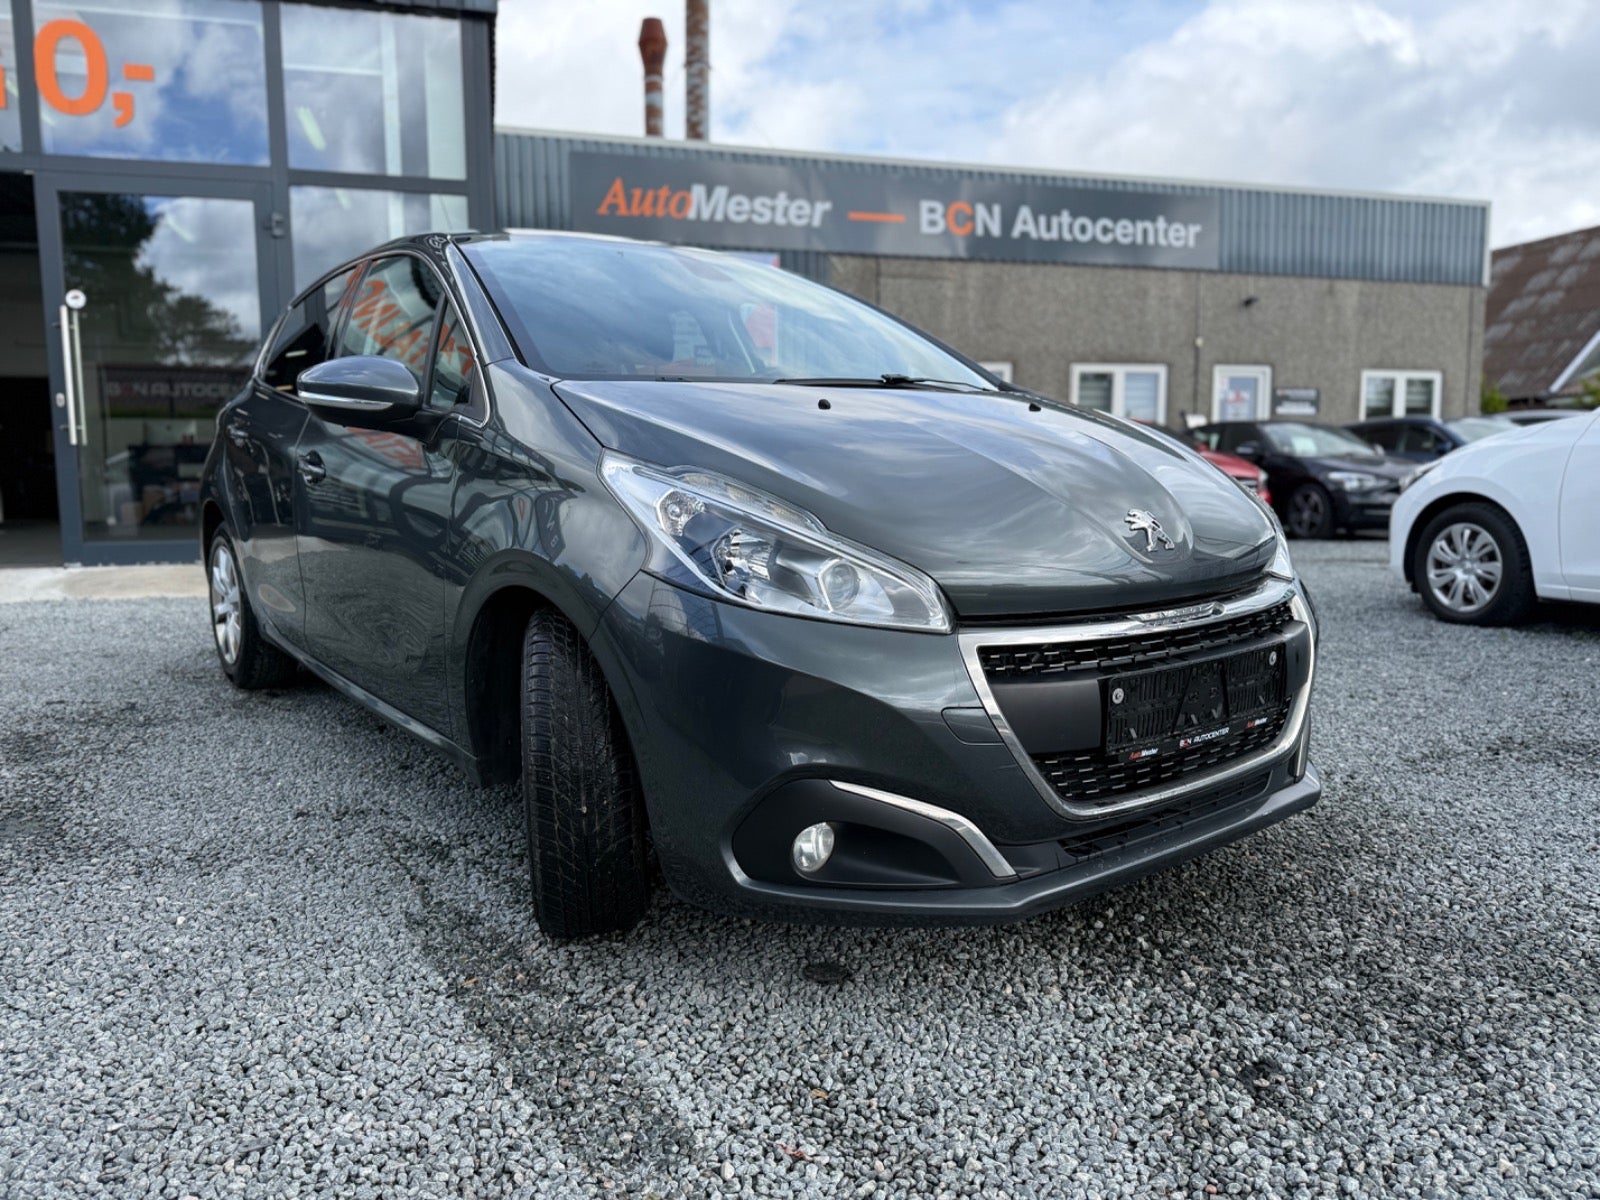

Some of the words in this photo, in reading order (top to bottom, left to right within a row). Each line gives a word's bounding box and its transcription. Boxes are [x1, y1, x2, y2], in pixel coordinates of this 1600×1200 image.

[597, 176, 833, 228] AutoMester
[918, 199, 1001, 237] BCN
[1010, 204, 1201, 248] Autocenter
[1194, 727, 1229, 742] AUTOCENTER
